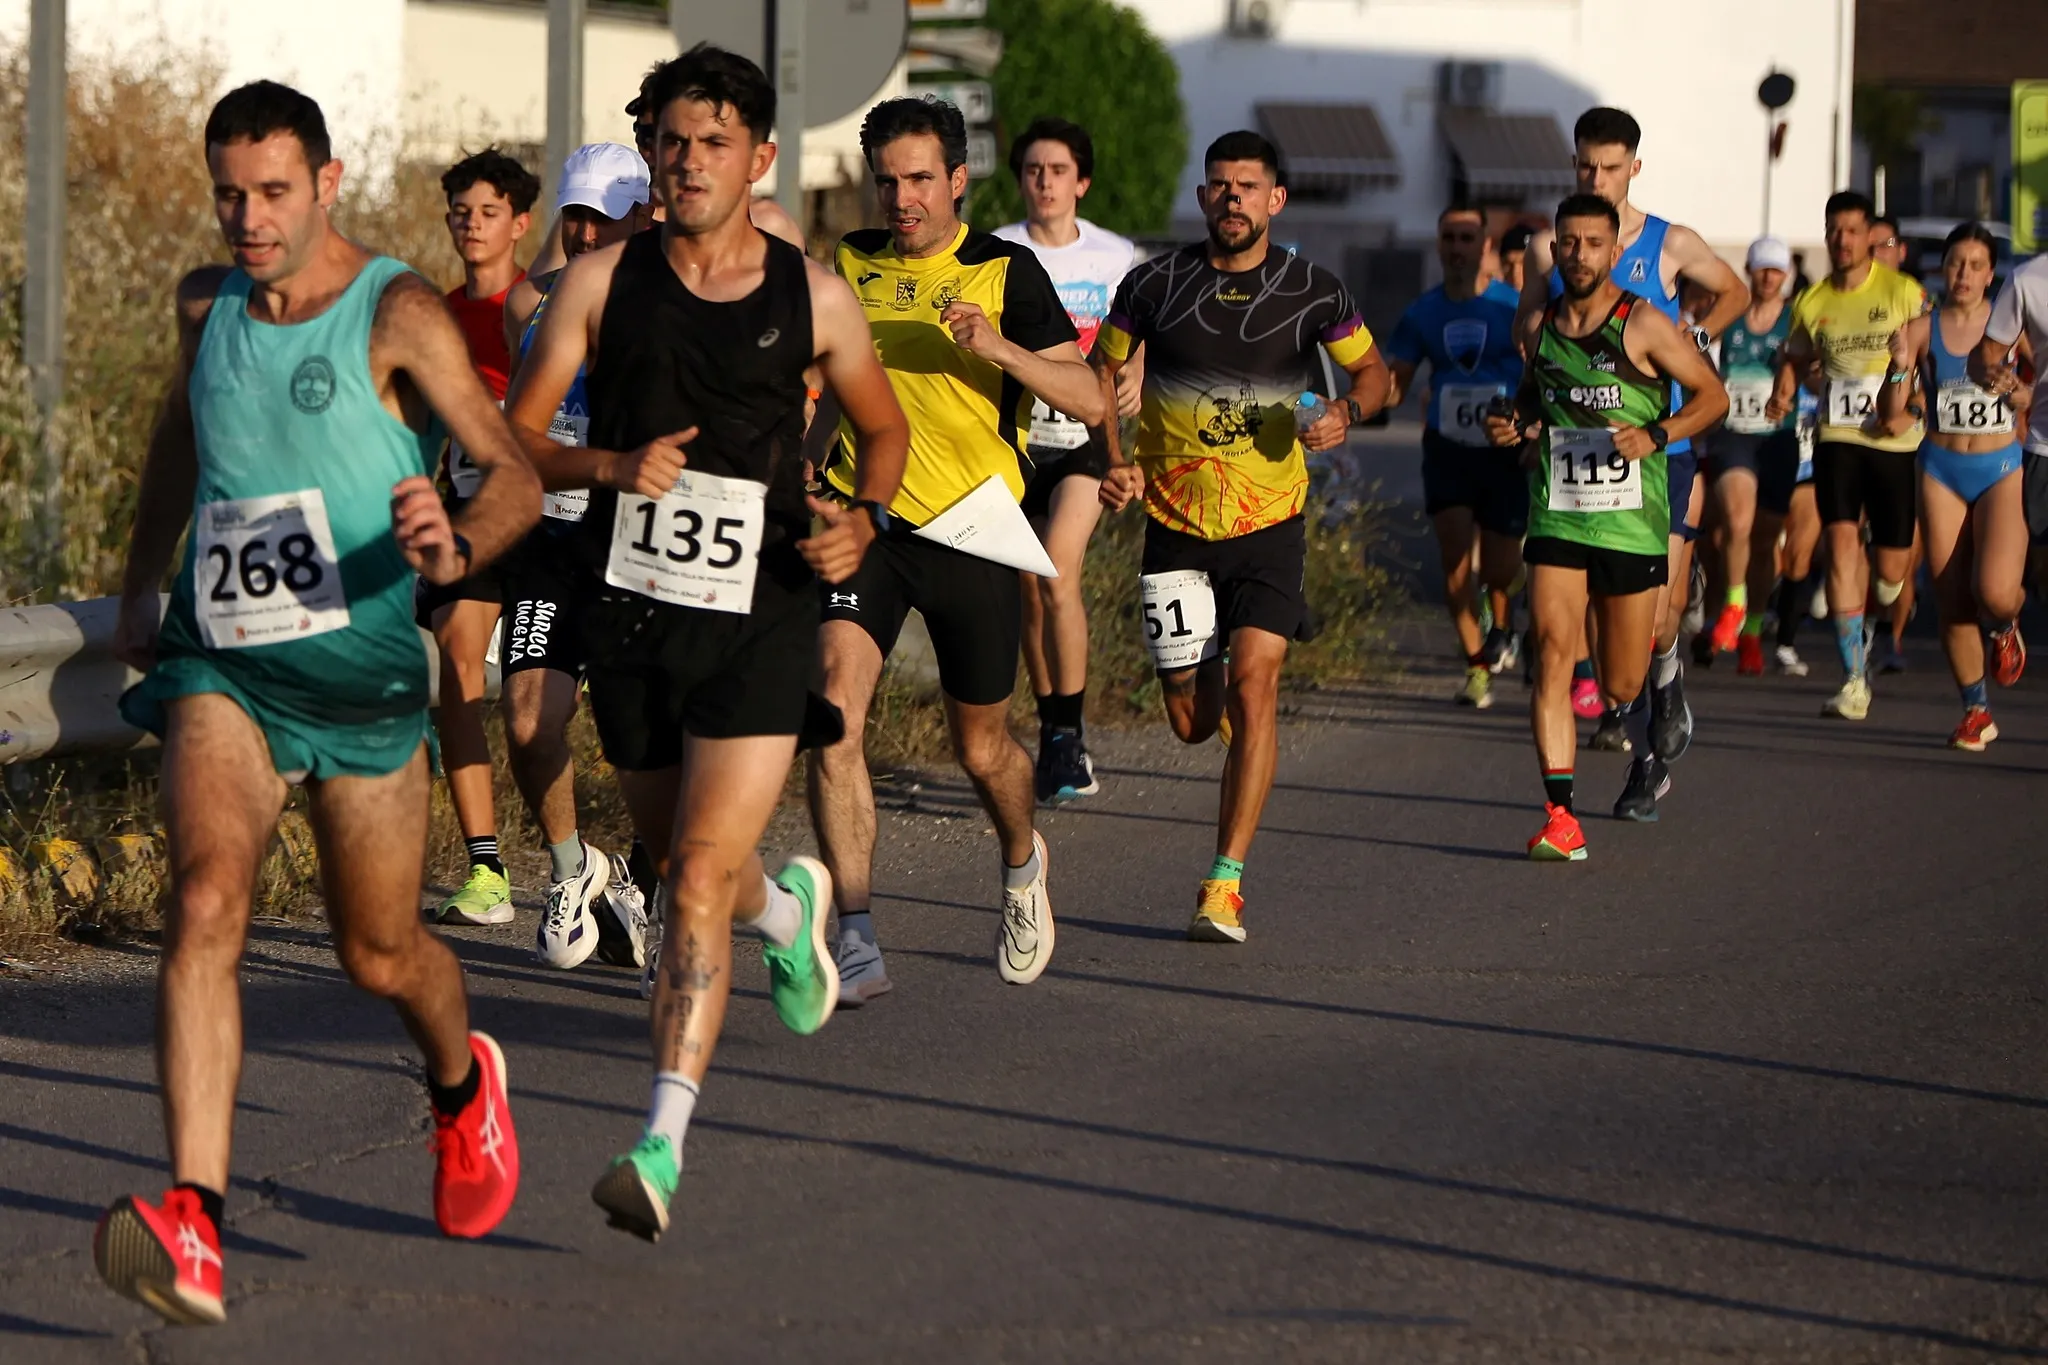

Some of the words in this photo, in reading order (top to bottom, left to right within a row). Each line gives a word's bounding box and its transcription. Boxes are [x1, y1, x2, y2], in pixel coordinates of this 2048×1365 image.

[1592, 400, 1623, 410] TRAIL
[1948, 400, 2007, 428] 181
[1561, 449, 1632, 485] 119
[561, 507, 577, 515] Pedro
[630, 501, 745, 570] 135
[208, 533, 323, 602] 268
[527, 600, 557, 658] SURCO
[1143, 599, 1193, 640] 51
